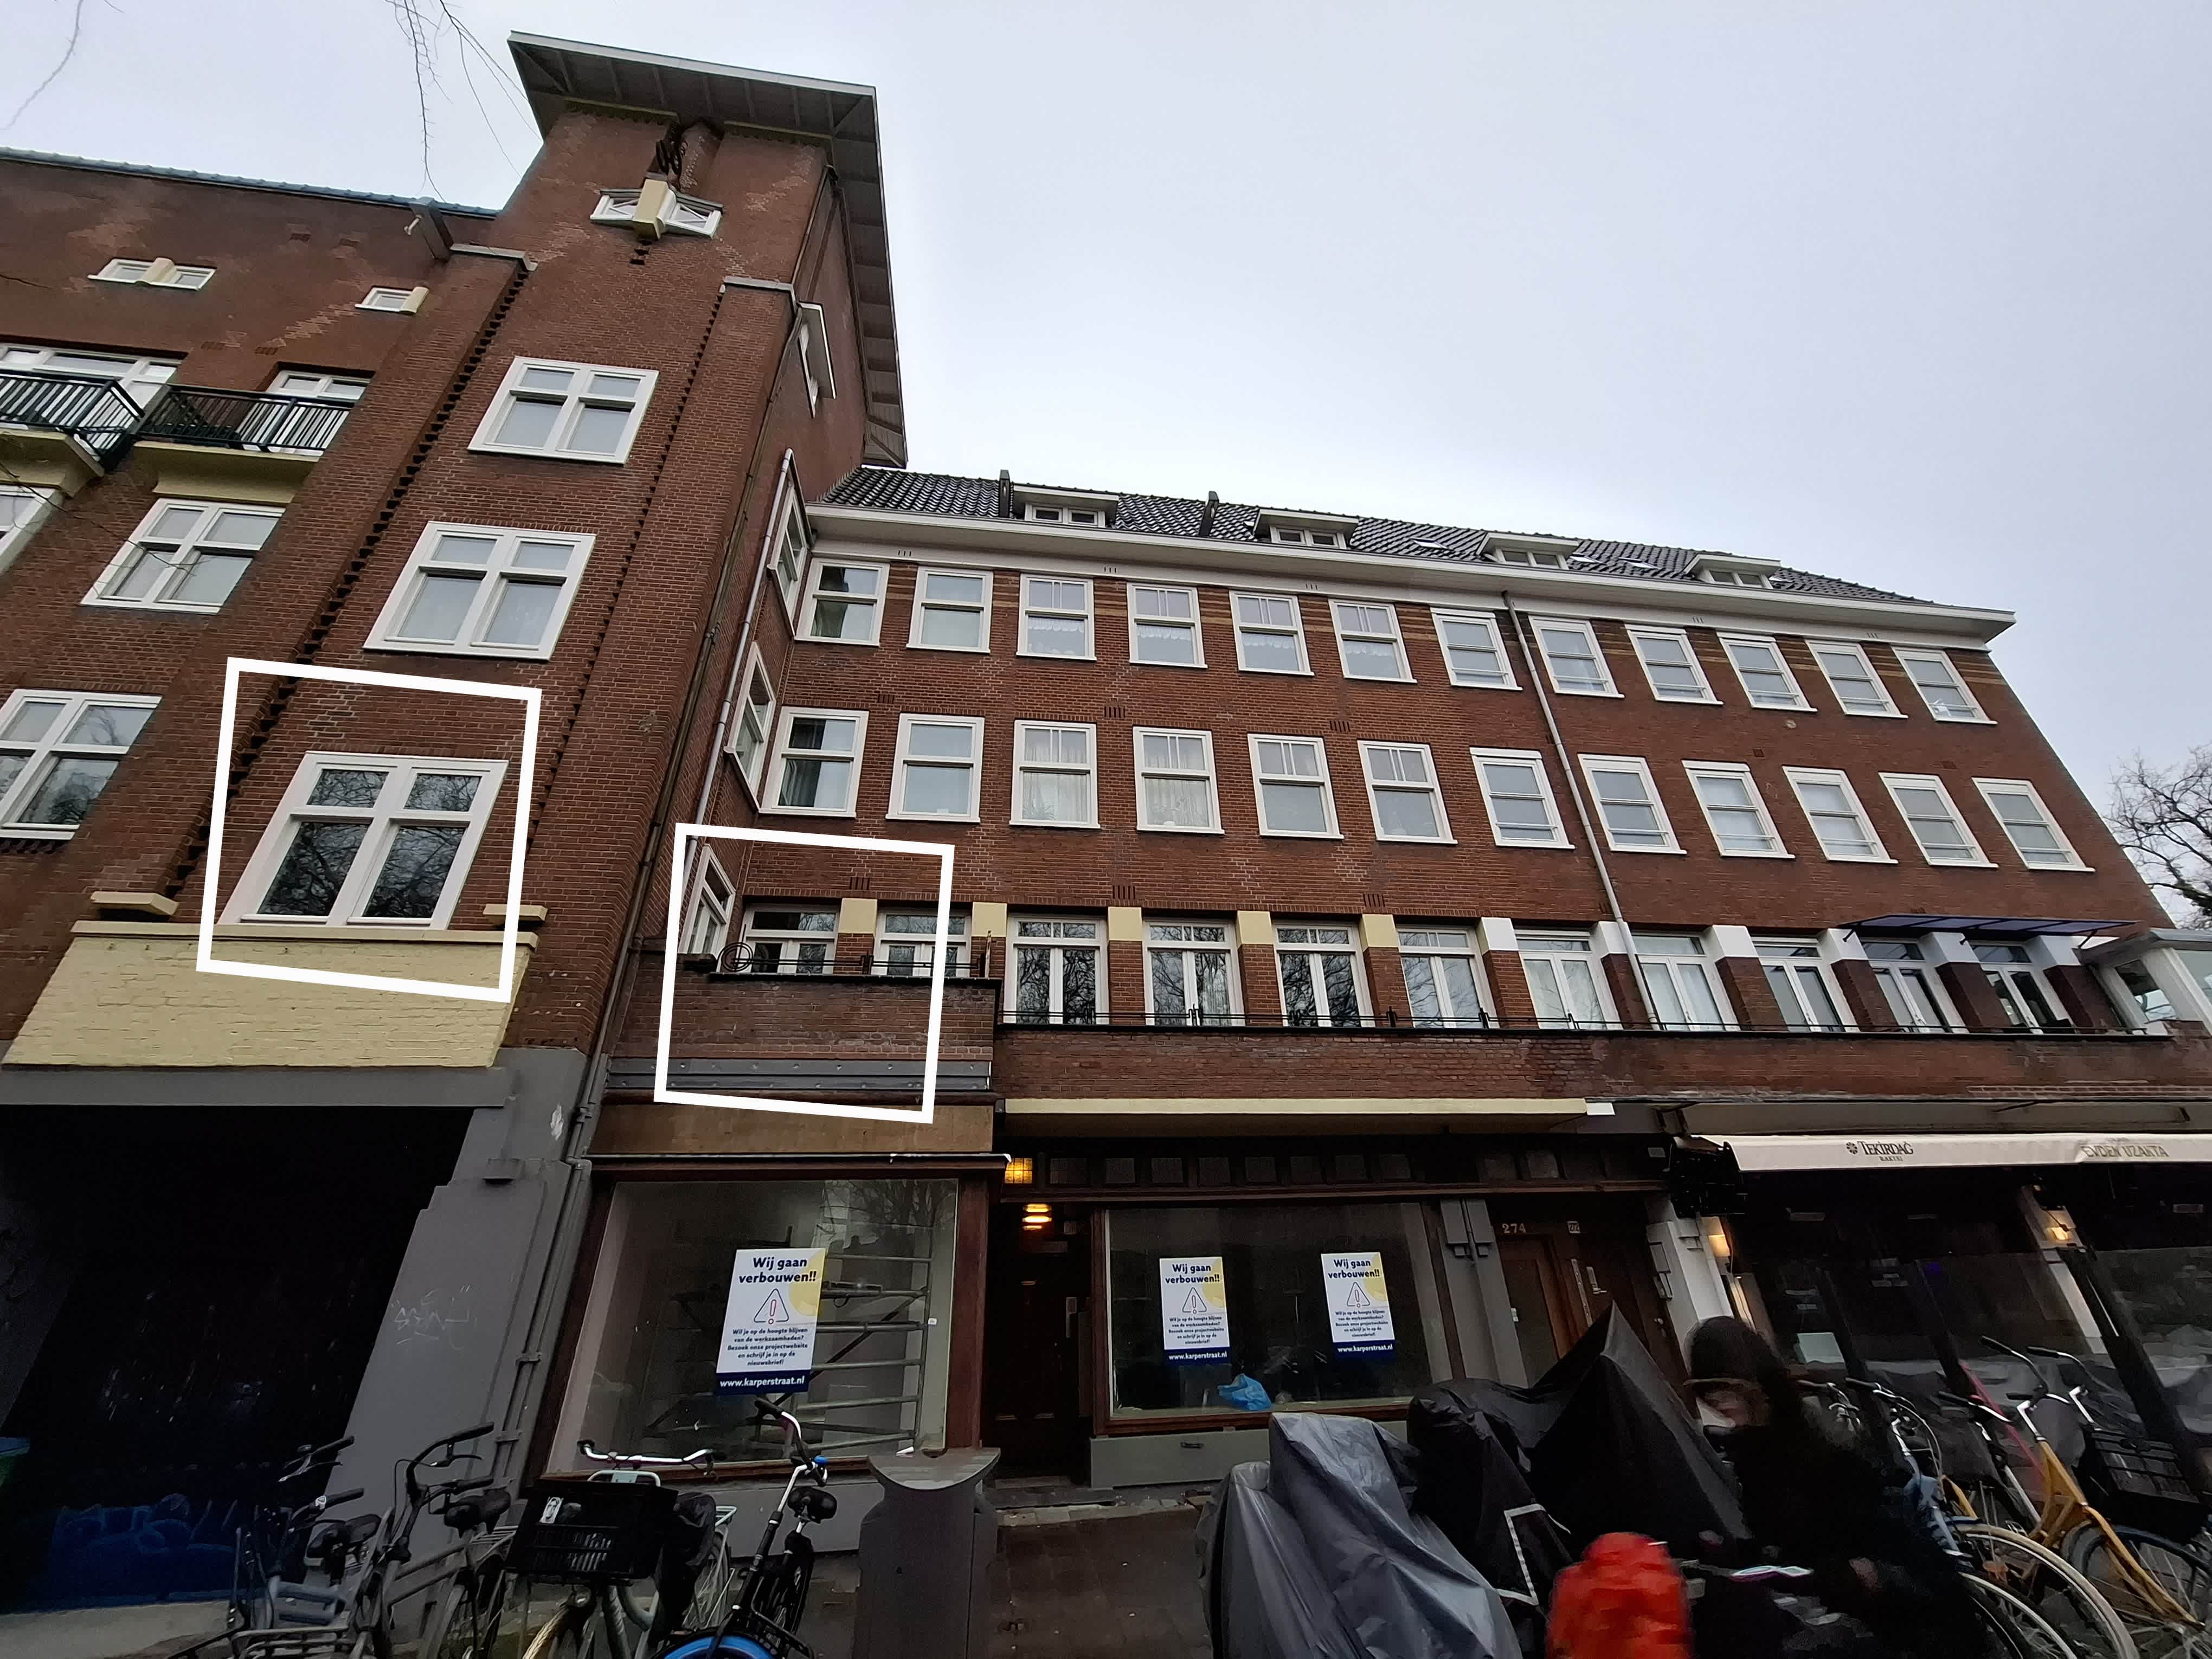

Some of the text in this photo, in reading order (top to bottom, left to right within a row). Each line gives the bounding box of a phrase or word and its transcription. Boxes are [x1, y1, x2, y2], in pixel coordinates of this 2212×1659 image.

[1502, 1223, 1526, 1233] 274
[753, 1257, 807, 1270] Wij gaan
[1333, 1259, 1371, 1269] Wij gaan
[1172, 1264, 1211, 1274] Wij gaan
[1328, 1269, 1380, 1278] verbouwen!!
[739, 1271, 816, 1283] verbouwen!!
[1165, 1274, 1220, 1283] verbouwen!!
[720, 1375, 805, 1388] www.karperstraat.nl
